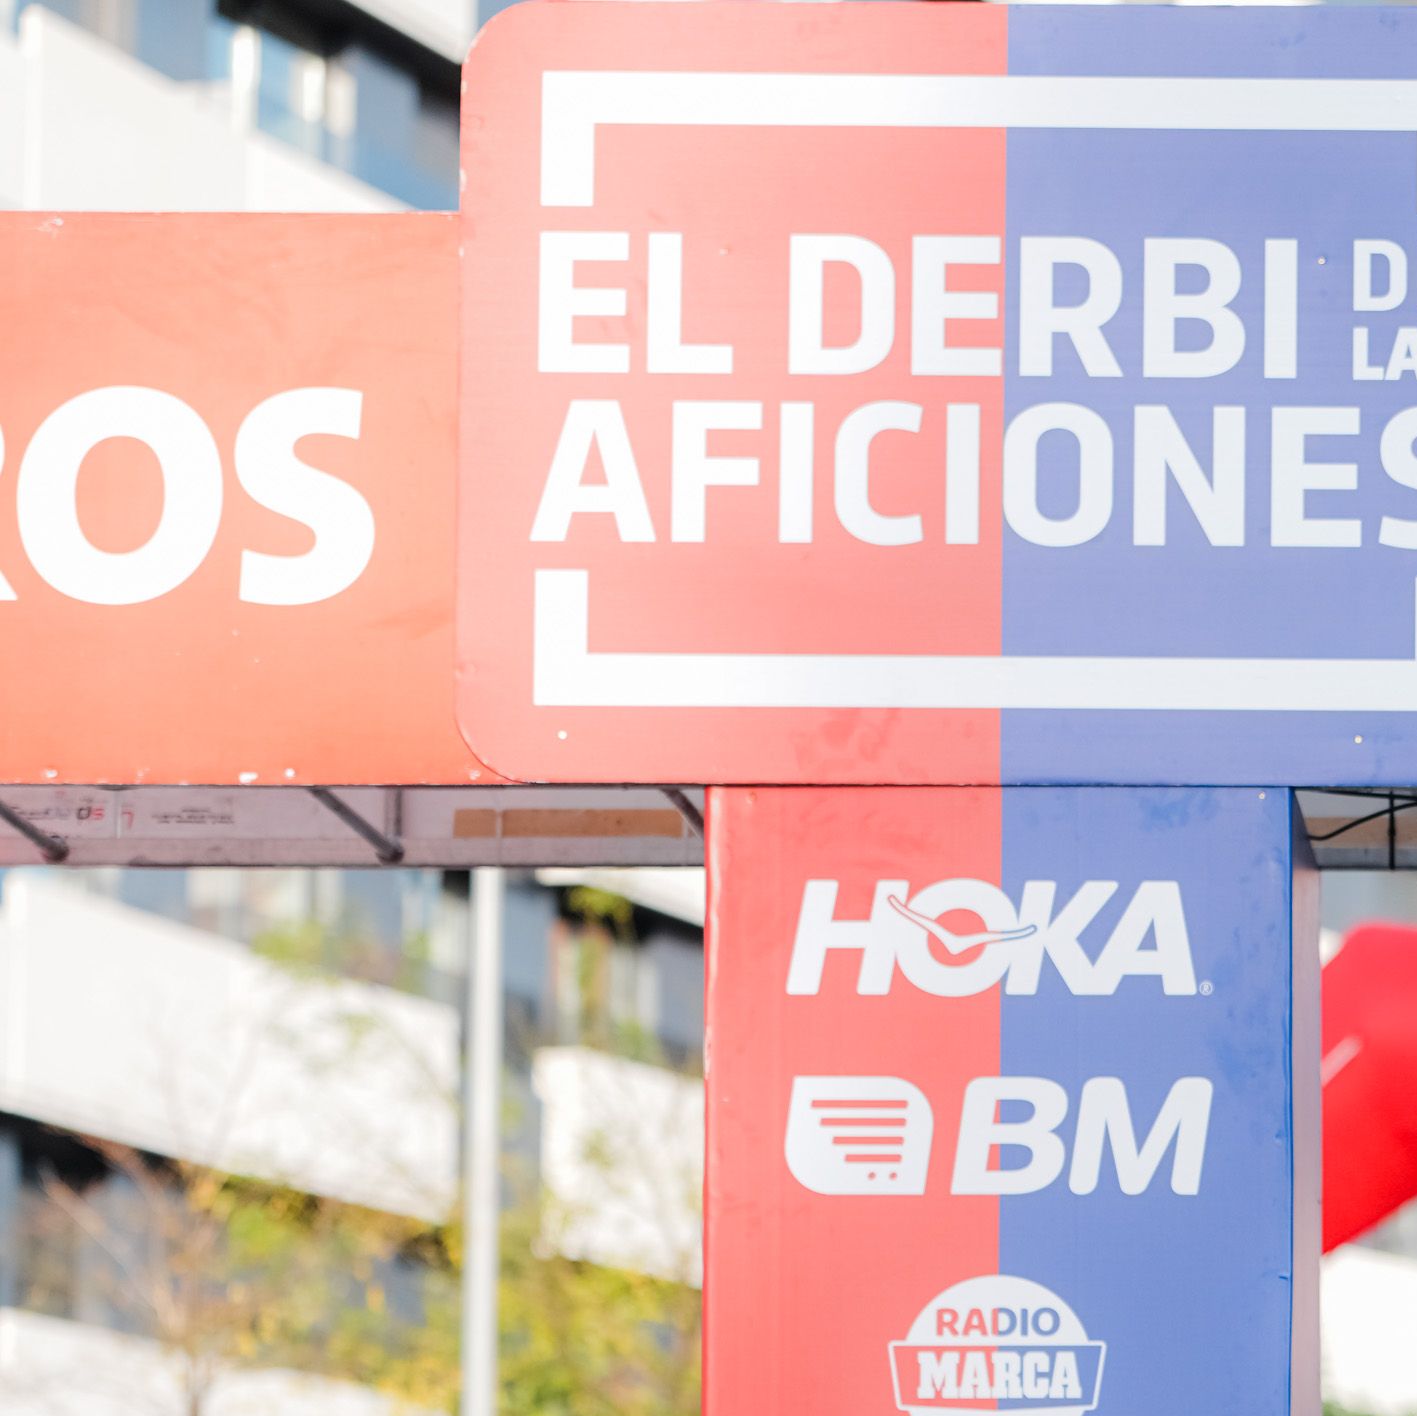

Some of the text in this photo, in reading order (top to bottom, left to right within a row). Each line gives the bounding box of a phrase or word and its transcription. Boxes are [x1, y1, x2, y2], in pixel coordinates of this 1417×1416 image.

[538, 231, 733, 373] EL
[788, 234, 1297, 378] DERBI
[785, 877, 1198, 997] HOKA
[951, 1077, 1212, 1195] BM
[917, 1351, 1082, 1400] MARCA
[936, 1307, 1060, 1337] RADIO
